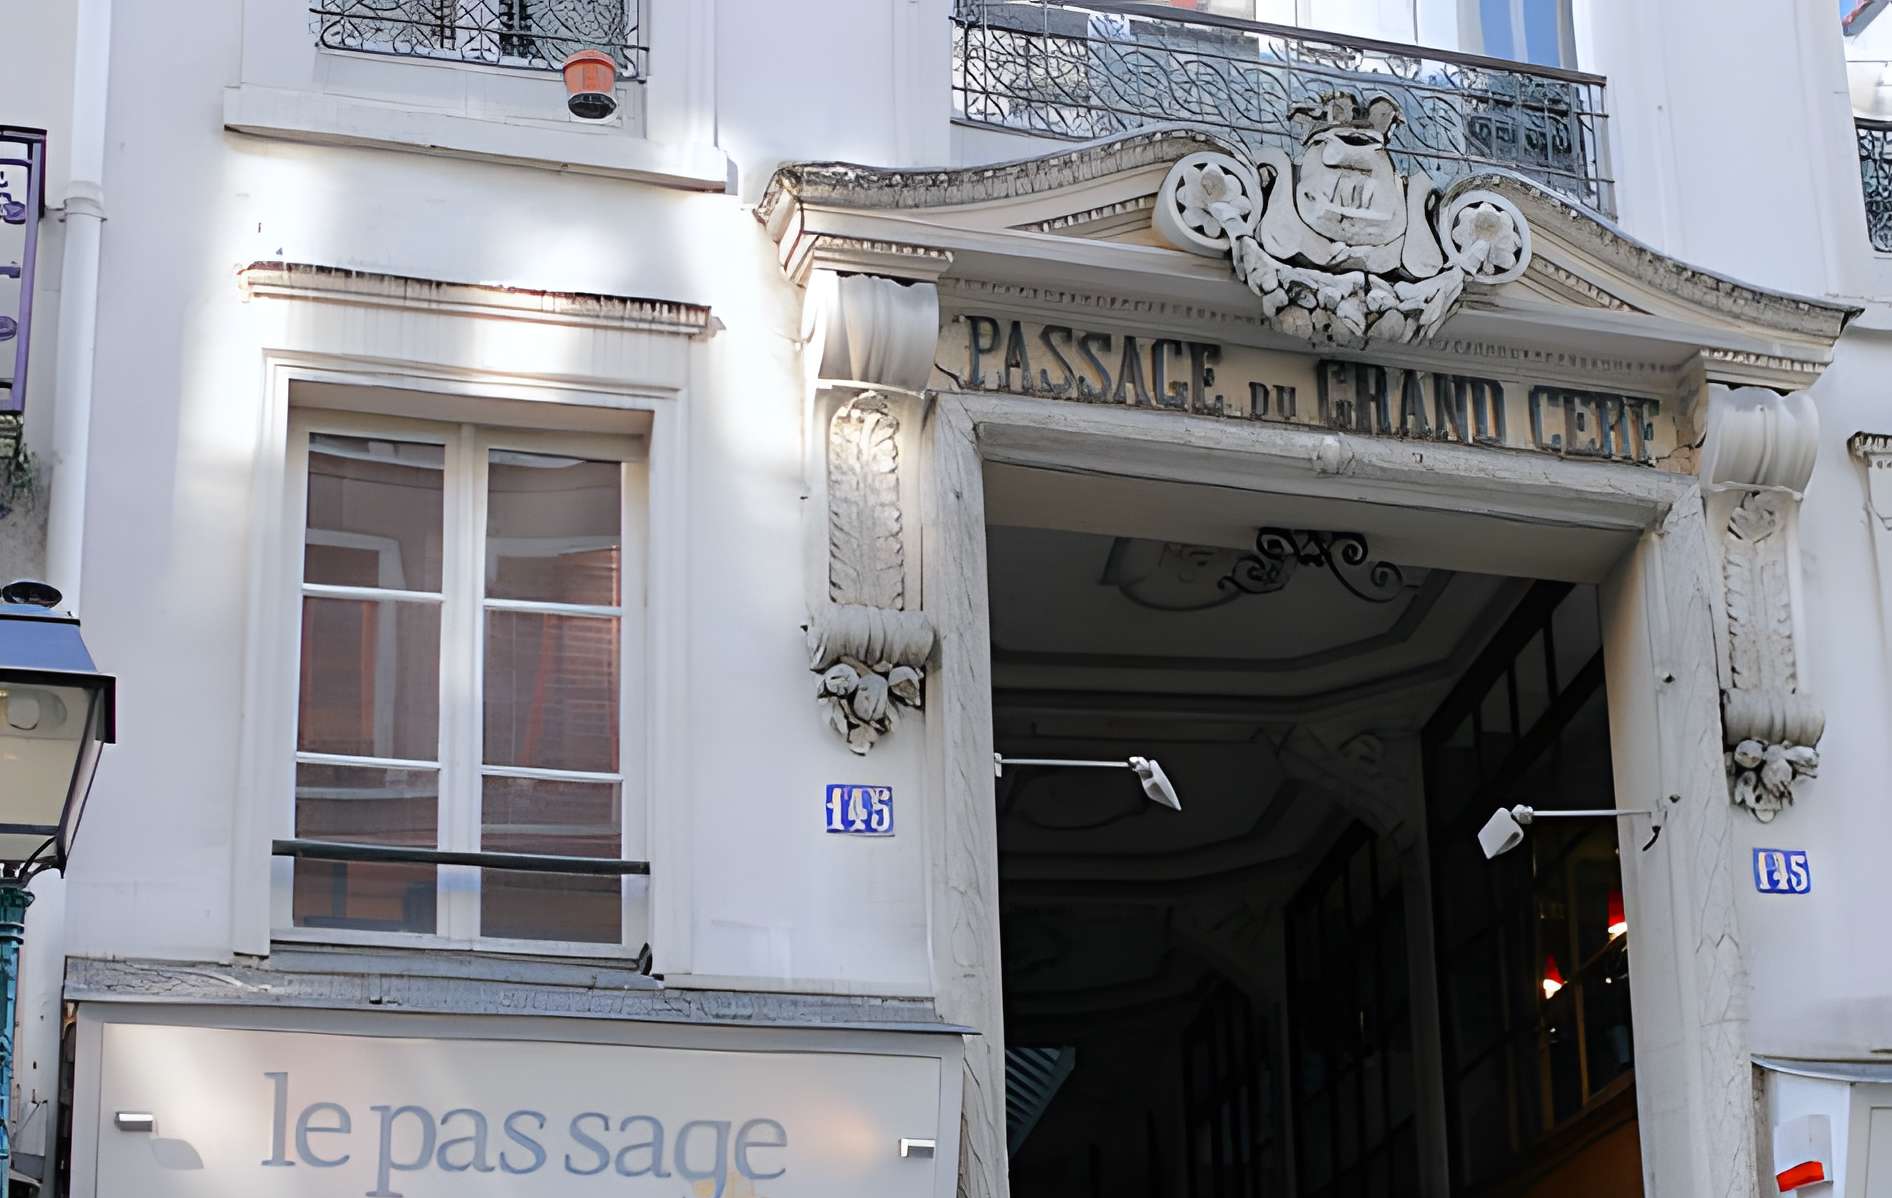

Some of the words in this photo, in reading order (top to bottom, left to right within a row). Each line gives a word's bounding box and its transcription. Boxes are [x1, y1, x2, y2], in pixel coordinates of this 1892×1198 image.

[965, 314, 1222, 411] PASSAGE
[1316, 358, 1505, 444] GRAND
[1529, 384, 1661, 463] CERF
[826, 786, 890, 832] 145
[1758, 851, 1809, 892] 145
[261, 1071, 352, 1168] le
